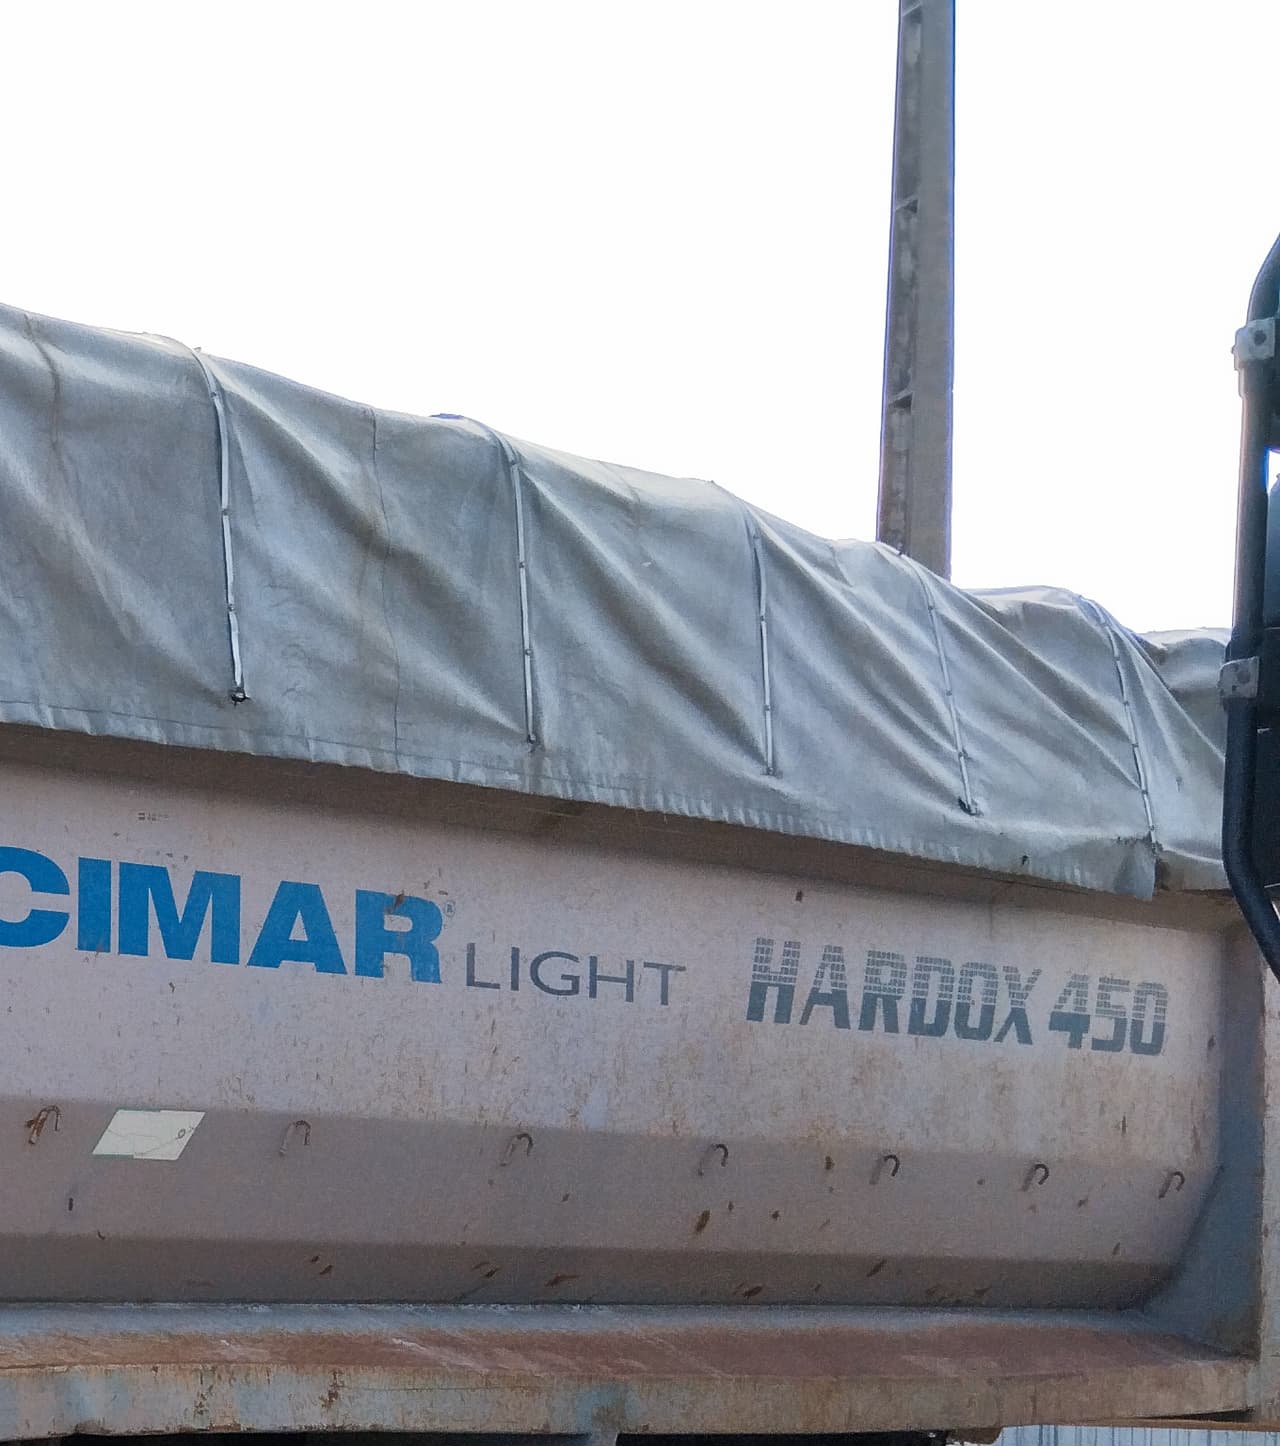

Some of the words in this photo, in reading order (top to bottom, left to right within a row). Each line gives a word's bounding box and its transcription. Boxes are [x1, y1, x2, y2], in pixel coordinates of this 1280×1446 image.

[466, 942, 687, 1006] LIGHT
[746, 937, 1043, 1046] HARDOX
[1048, 973, 1169, 1057] 450
